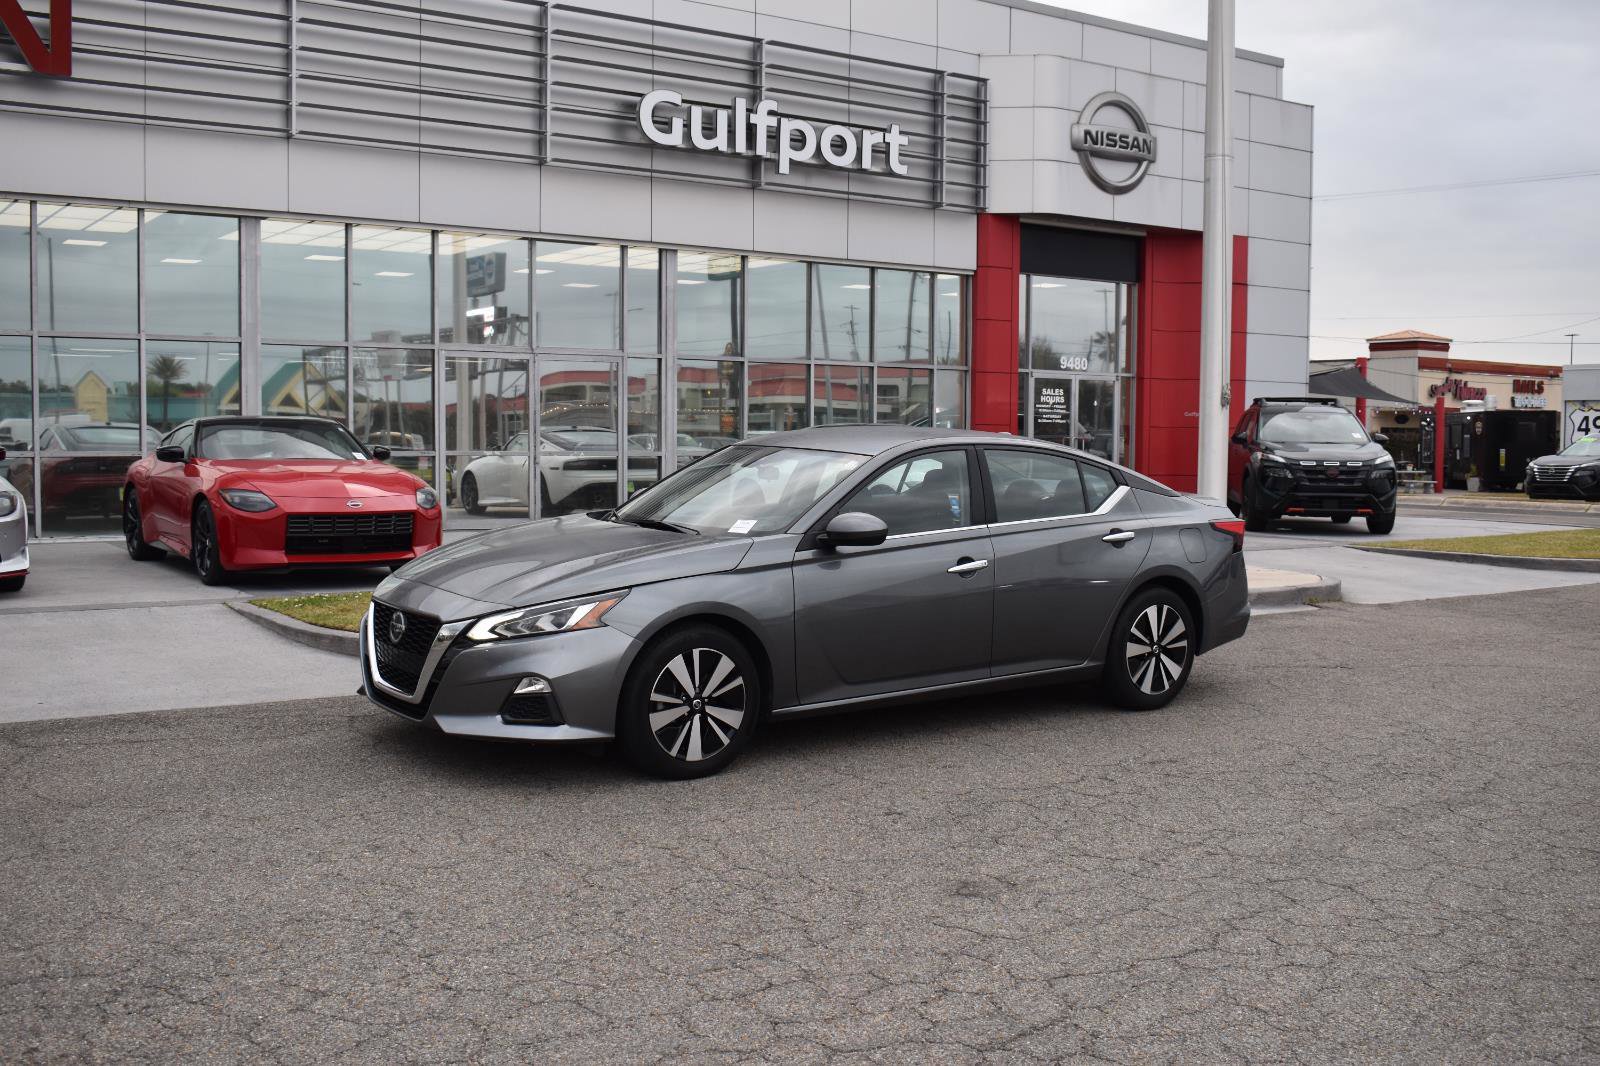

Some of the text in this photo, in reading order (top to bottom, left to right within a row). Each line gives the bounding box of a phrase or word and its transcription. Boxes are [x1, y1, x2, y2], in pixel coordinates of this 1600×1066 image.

[639, 89, 909, 175] Gulfport
[1083, 129, 1152, 155] NISSAN
[1060, 356, 1088, 370] 9480
[1042, 388, 1064, 396] SALES
